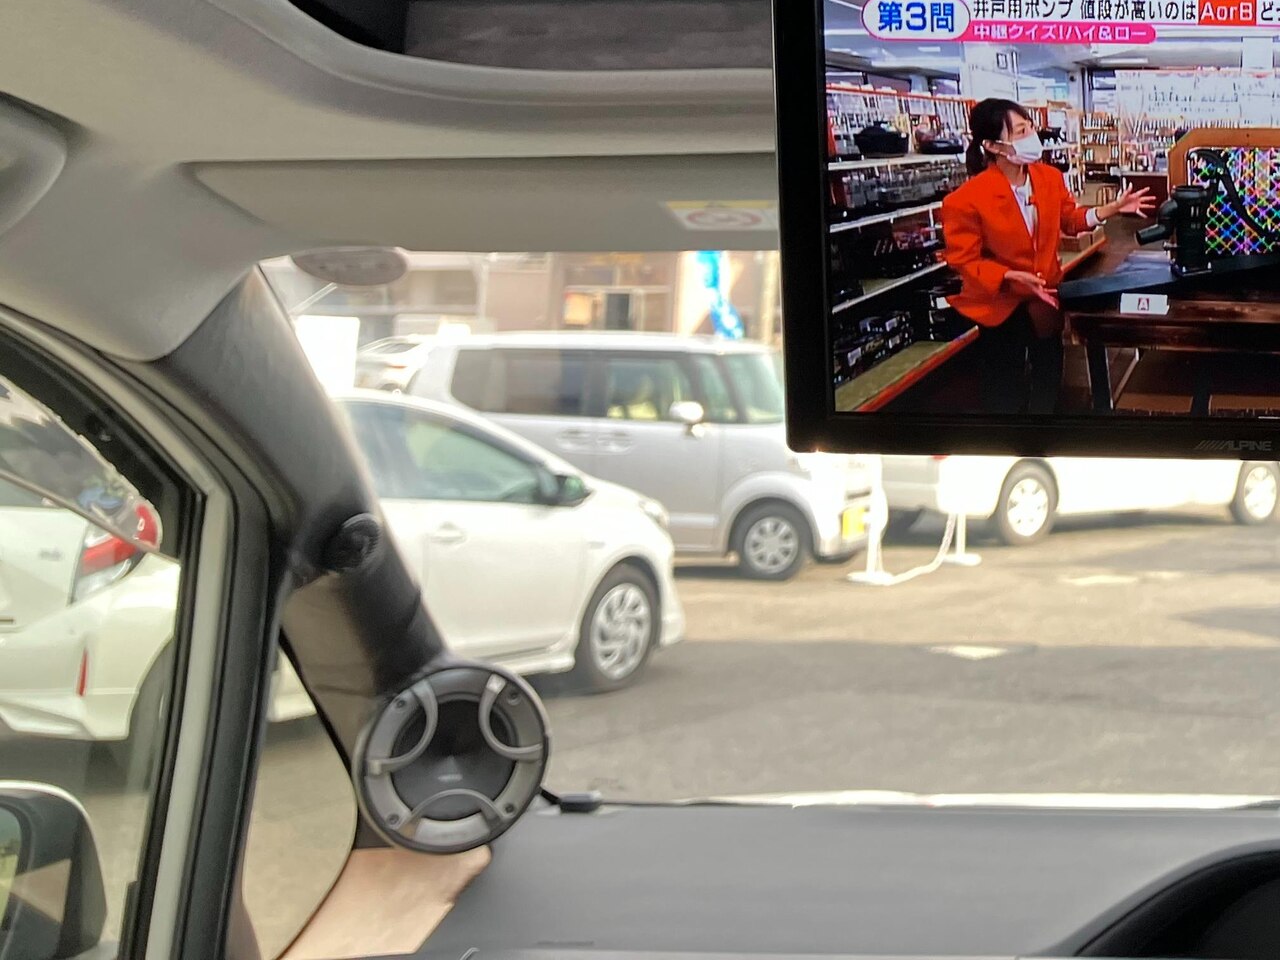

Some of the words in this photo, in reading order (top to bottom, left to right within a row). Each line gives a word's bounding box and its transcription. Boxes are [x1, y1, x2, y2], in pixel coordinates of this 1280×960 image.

[877, 0, 955, 32] 第3問
[1080, 0, 1196, 21] 値段が高いのは
[1219, 440, 1272, 451] ALPINE
